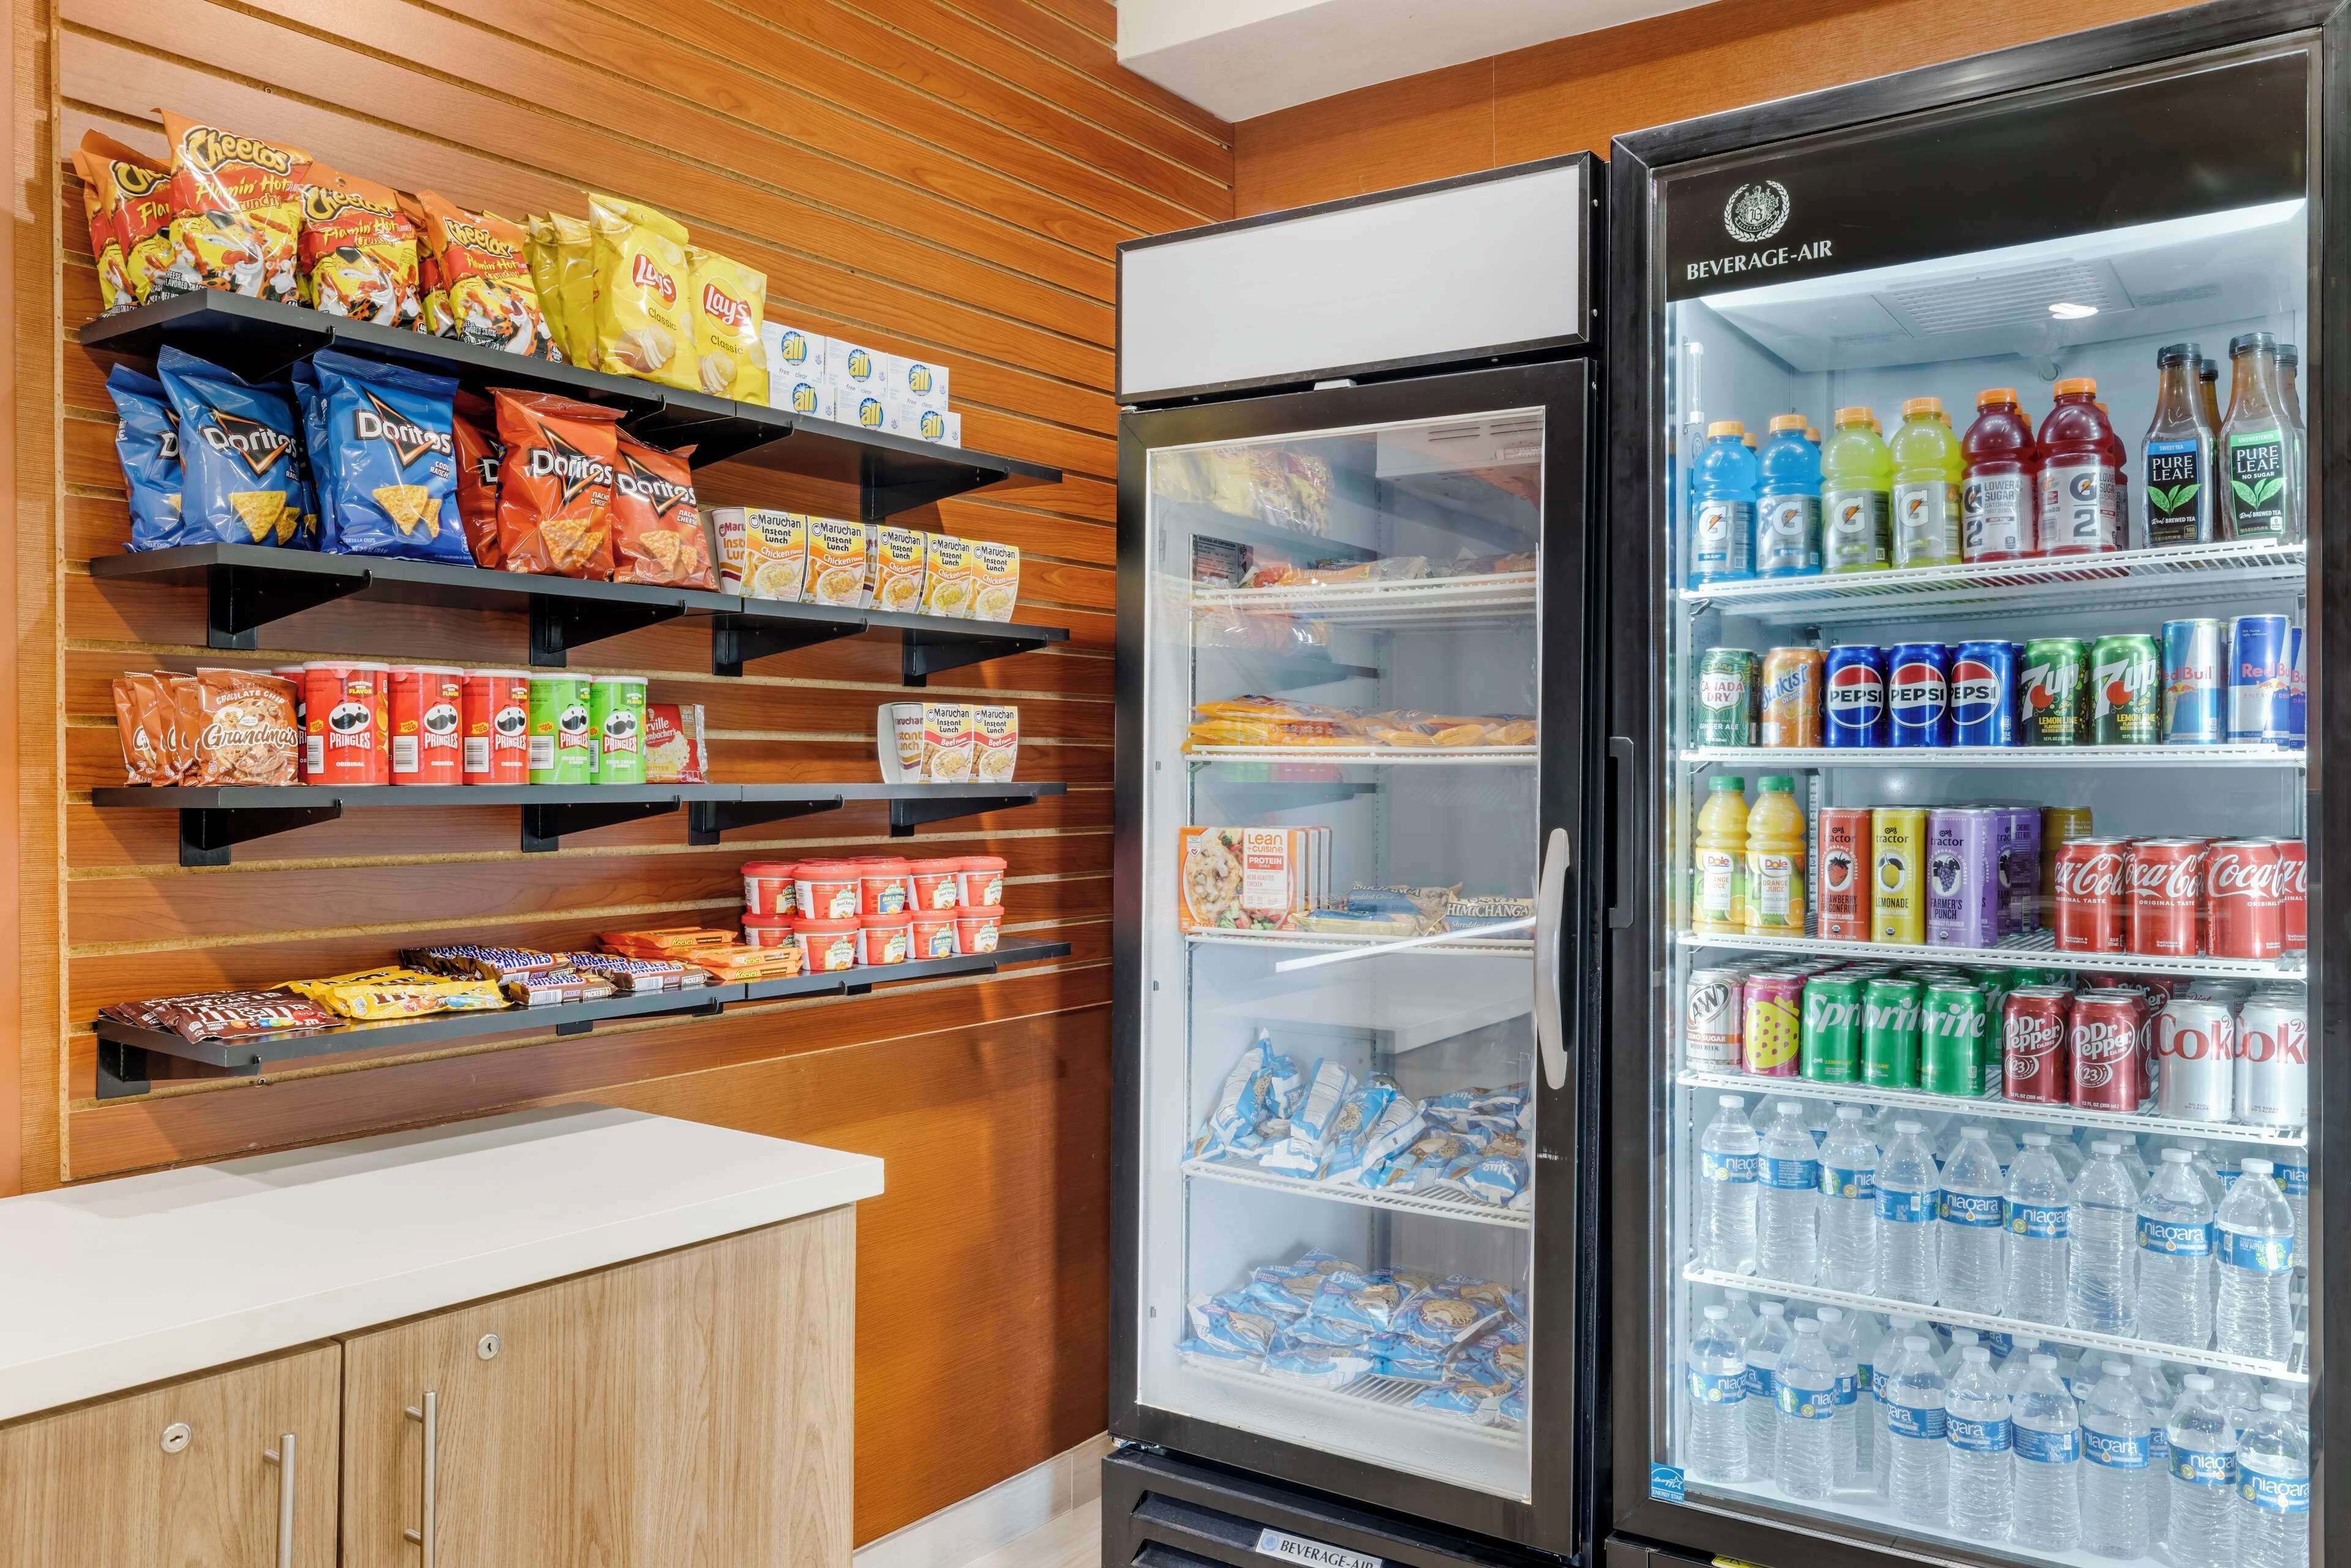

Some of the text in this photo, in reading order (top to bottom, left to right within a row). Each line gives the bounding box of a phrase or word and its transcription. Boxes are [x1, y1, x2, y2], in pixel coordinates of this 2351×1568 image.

[186, 127, 291, 174] Cheetos
[195, 176, 257, 204] Flamin'
[259, 174, 290, 193] Hot
[306, 186, 392, 220] Cheetos
[321, 218, 397, 245] Flamin' Hot
[1738, 217, 1774, 231] BEVERAGE-AIR
[445, 220, 511, 256] Cheetos
[464, 252, 518, 270] Flamin' Hot
[1687, 240, 1832, 280] BEVERAGE-AIR
[636, 254, 672, 297] Lay's
[705, 283, 751, 327] Lay's
[648, 307, 677, 331] Classic
[710, 335, 744, 355] Classic
[782, 336, 804, 360] all
[849, 354, 869, 377] all
[795, 372, 808, 380] clear
[910, 369, 930, 391] all
[793, 388, 815, 412] all
[860, 402, 881, 426] all
[358, 411, 451, 454] Doritos
[921, 415, 942, 437] all
[203, 427, 297, 459] Doritos
[2238, 433, 2273, 444] UNSWEETENED
[2237, 446, 2278, 460] PURE
[435, 461, 450, 471] COOL
[531, 449, 612, 485] Doritos
[2153, 456, 2192, 470] PURE
[430, 468, 449, 479] RANCH
[617, 473, 696, 505] Doritos
[1985, 481, 2014, 491] LOWER
[2069, 472, 2096, 501] G
[590, 498, 607, 507] CHEESE
[592, 492, 610, 500] NACHO
[1964, 483, 1982, 513] G
[1985, 490, 2014, 501] SUGAR
[679, 509, 698, 519] NACHO
[1834, 498, 1865, 533] G
[1898, 490, 1929, 527] G
[677, 516, 697, 525] CHEESE
[759, 514, 801, 529] Maruchan
[1698, 506, 1727, 541] G
[1772, 501, 1803, 536] G
[2074, 509, 2097, 537] 2
[762, 526, 791, 537] Instant
[820, 522, 861, 537] Maruchan
[1967, 520, 1982, 548] 2
[765, 536, 788, 544] Lunch
[824, 534, 852, 545] Instant
[888, 531, 920, 546] Maruchan
[937, 539, 970, 553] Maruchan
[761, 547, 790, 558] Chicken
[890, 543, 912, 553] Instant
[893, 551, 910, 560] Lunch
[940, 551, 962, 560] Instant
[981, 546, 1015, 559] Maruchan
[823, 553, 851, 566] Chicken
[890, 562, 912, 572] Chicken
[942, 558, 959, 567] Lunch
[938, 569, 960, 579] Chicken
[986, 564, 1005, 572] Lunch
[983, 574, 1005, 585] Chicken
[2242, 662, 2274, 678] Red
[1763, 663, 1808, 711] Sunkist
[1891, 688, 1944, 701] PEPSI
[264, 691, 285, 703] CHIP
[1707, 692, 1730, 702] DRY
[1782, 688, 1805, 704] Orange
[1831, 689, 1881, 703] PEPSI
[934, 708, 969, 718] Maruchan
[981, 710, 1014, 719] Maruchan
[203, 724, 298, 749] Grandma's
[330, 732, 370, 749] PRINGLES
[424, 732, 457, 749] PRINGLES
[495, 733, 526, 750] PRINGLES
[561, 732, 588, 748] PRINGLES
[940, 738, 955, 746] Beef
[988, 738, 1001, 747] Beef
[604, 736, 637, 754] PRINGLES
[1248, 833, 1283, 845] Lean
[1930, 836, 1964, 846] tractor
[1708, 857, 1730, 866] Dole
[1764, 859, 1787, 868] Dole
[1821, 894, 1857, 903] STRAWBERRY
[1876, 896, 1908, 908] LEMONADE
[1930, 899, 1962, 910] FARMER'S
[1446, 903, 1529, 917] HIMICHANGA
[1821, 904, 1858, 913] DRAGONFRUIT
[1935, 909, 1957, 920] PUNCH
[735, 970, 757, 979] Reese's
[1692, 984, 1720, 1024] A&W
[2019, 1016, 2045, 1035] Dr
[2090, 1022, 2118, 1041] Dr
[2004, 1018, 2060, 1052] Pepper
[2071, 1026, 2132, 1060] Pepper
[2012, 1059, 2025, 1074] 23
[2083, 1068, 2098, 1081] 23
[1947, 1192, 1998, 1214] niagara
[2145, 1221, 2205, 1243] niagara
[2084, 1432, 2138, 1455] niagara
[1653, 1489, 1670, 1498] ENERGY
